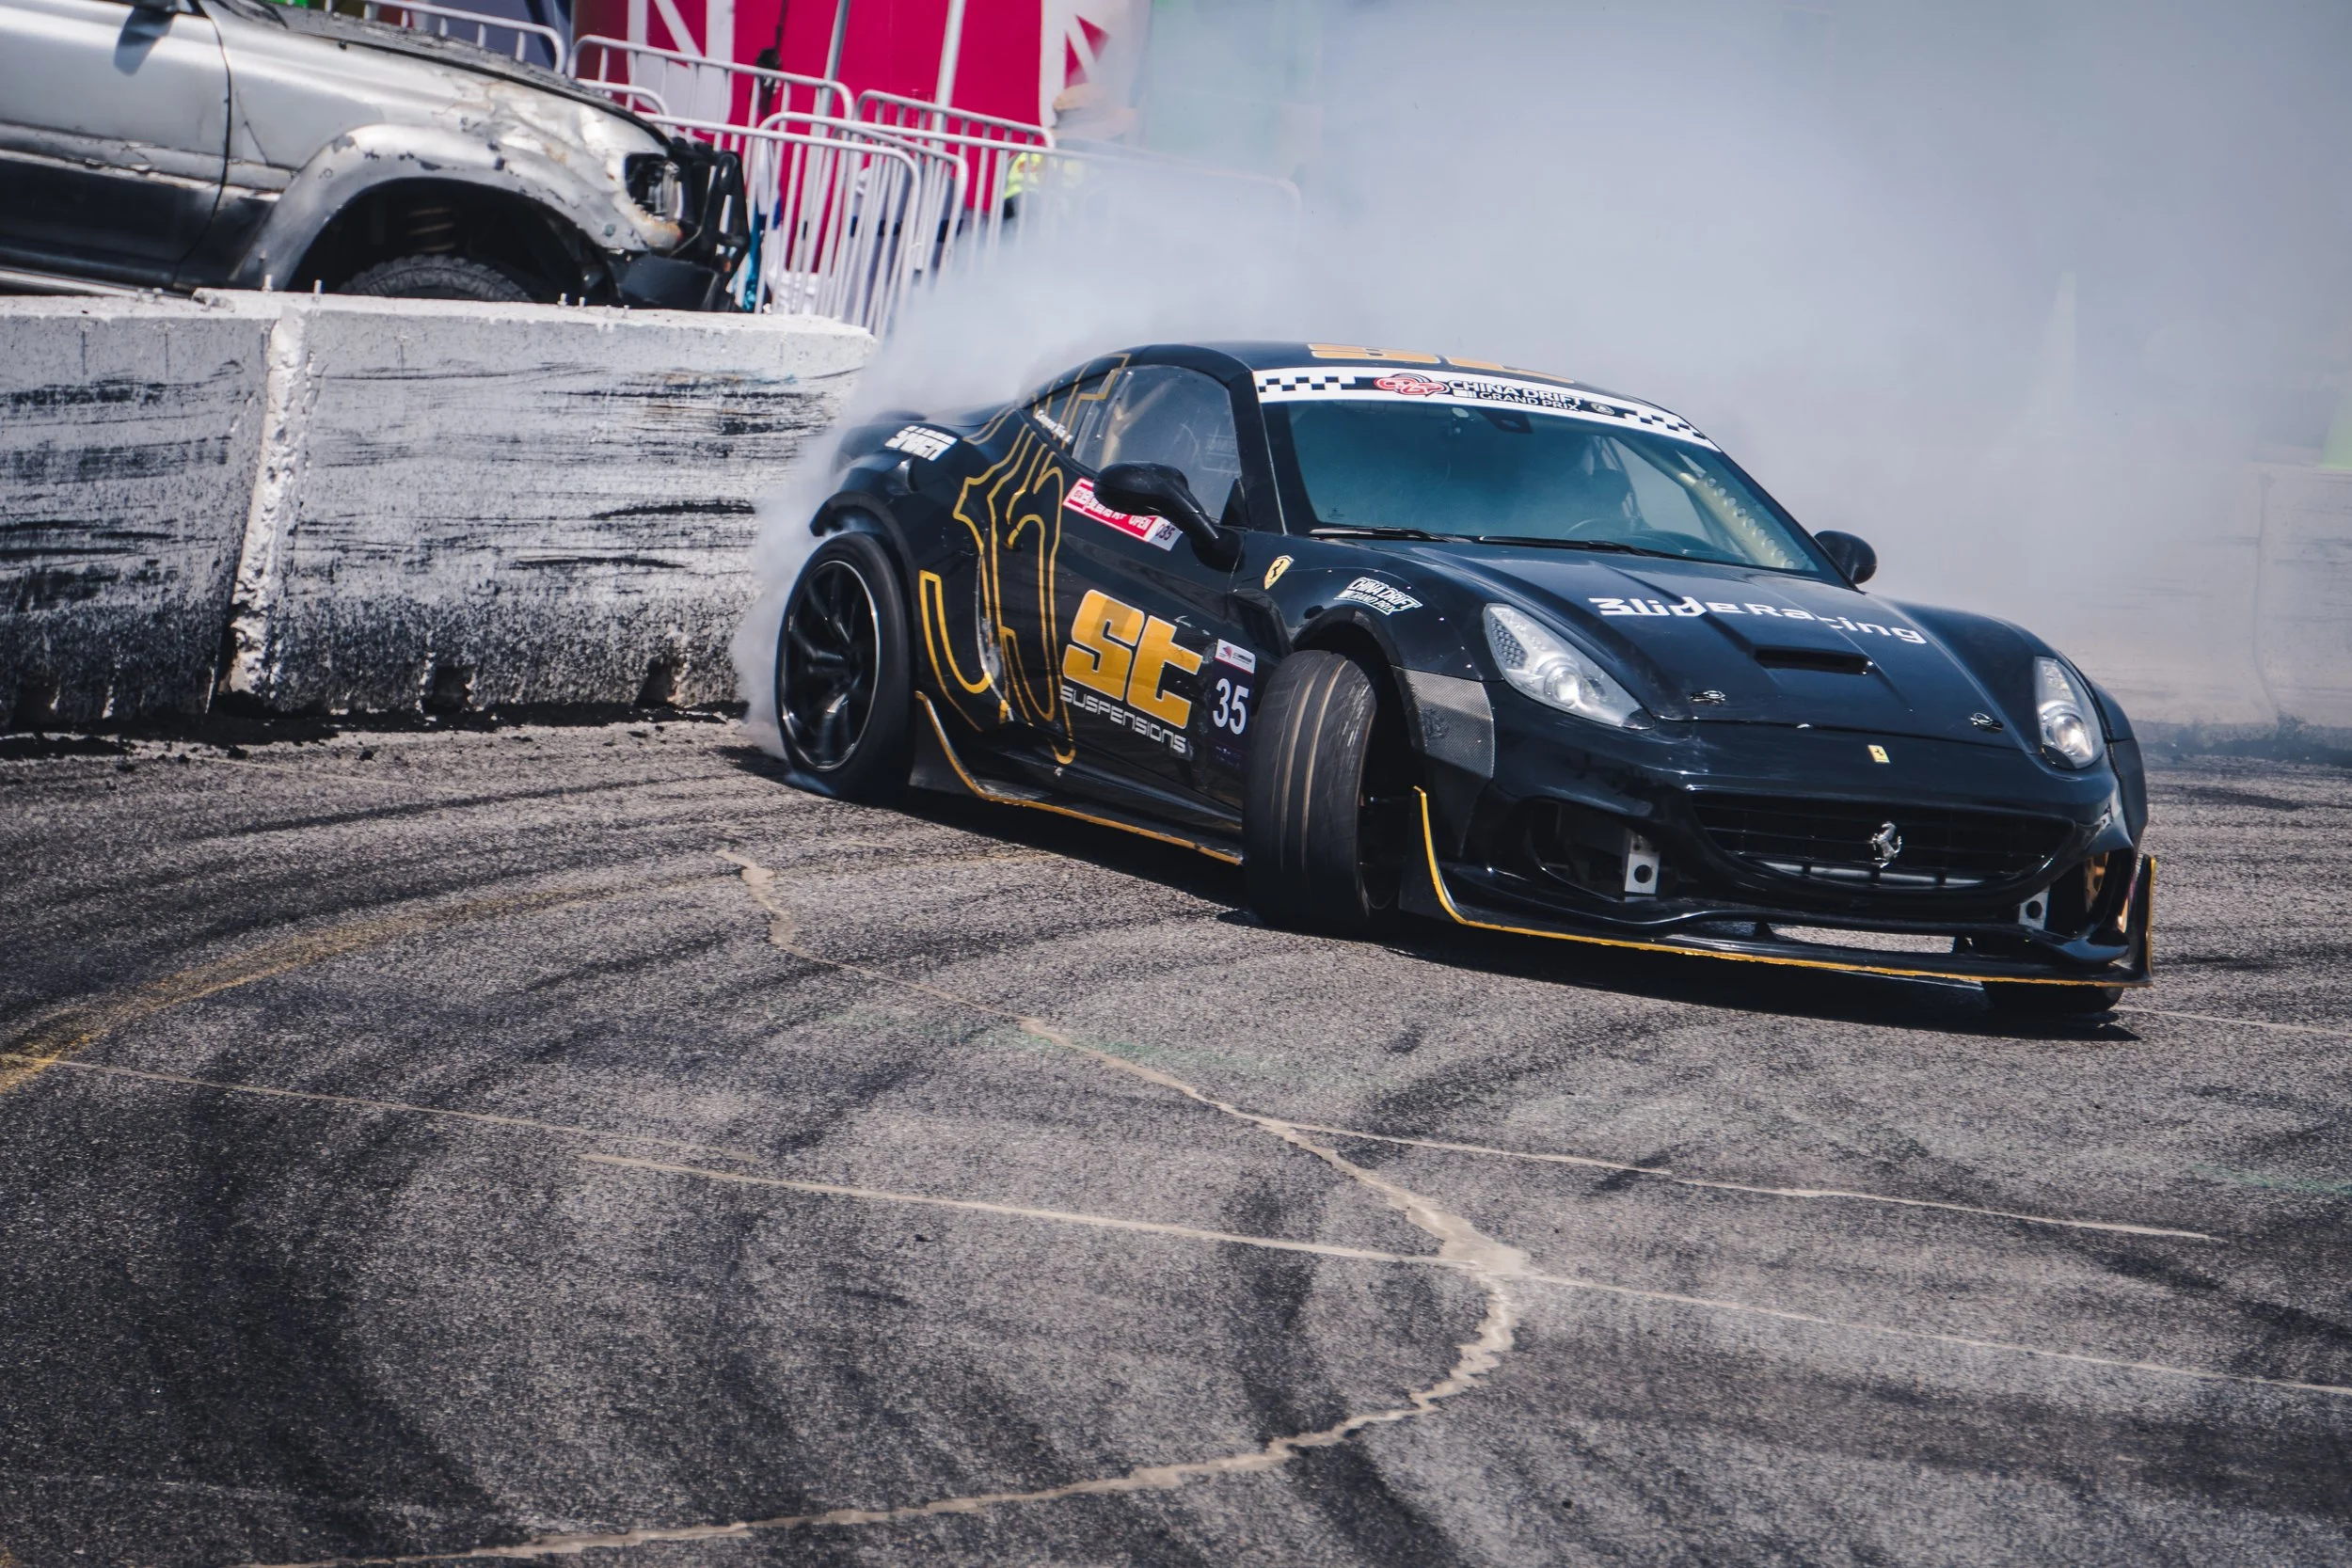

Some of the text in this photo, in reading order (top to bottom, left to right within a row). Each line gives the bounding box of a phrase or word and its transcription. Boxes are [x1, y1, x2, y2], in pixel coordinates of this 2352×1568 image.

[1449, 379, 1584, 406] CHINA DRIFT
[1480, 391, 1581, 411] GRAND PRIX
[1128, 515, 1152, 530] OPEN
[1351, 578, 1417, 610] CHINA DRIFT
[1212, 677, 1249, 736] 35
